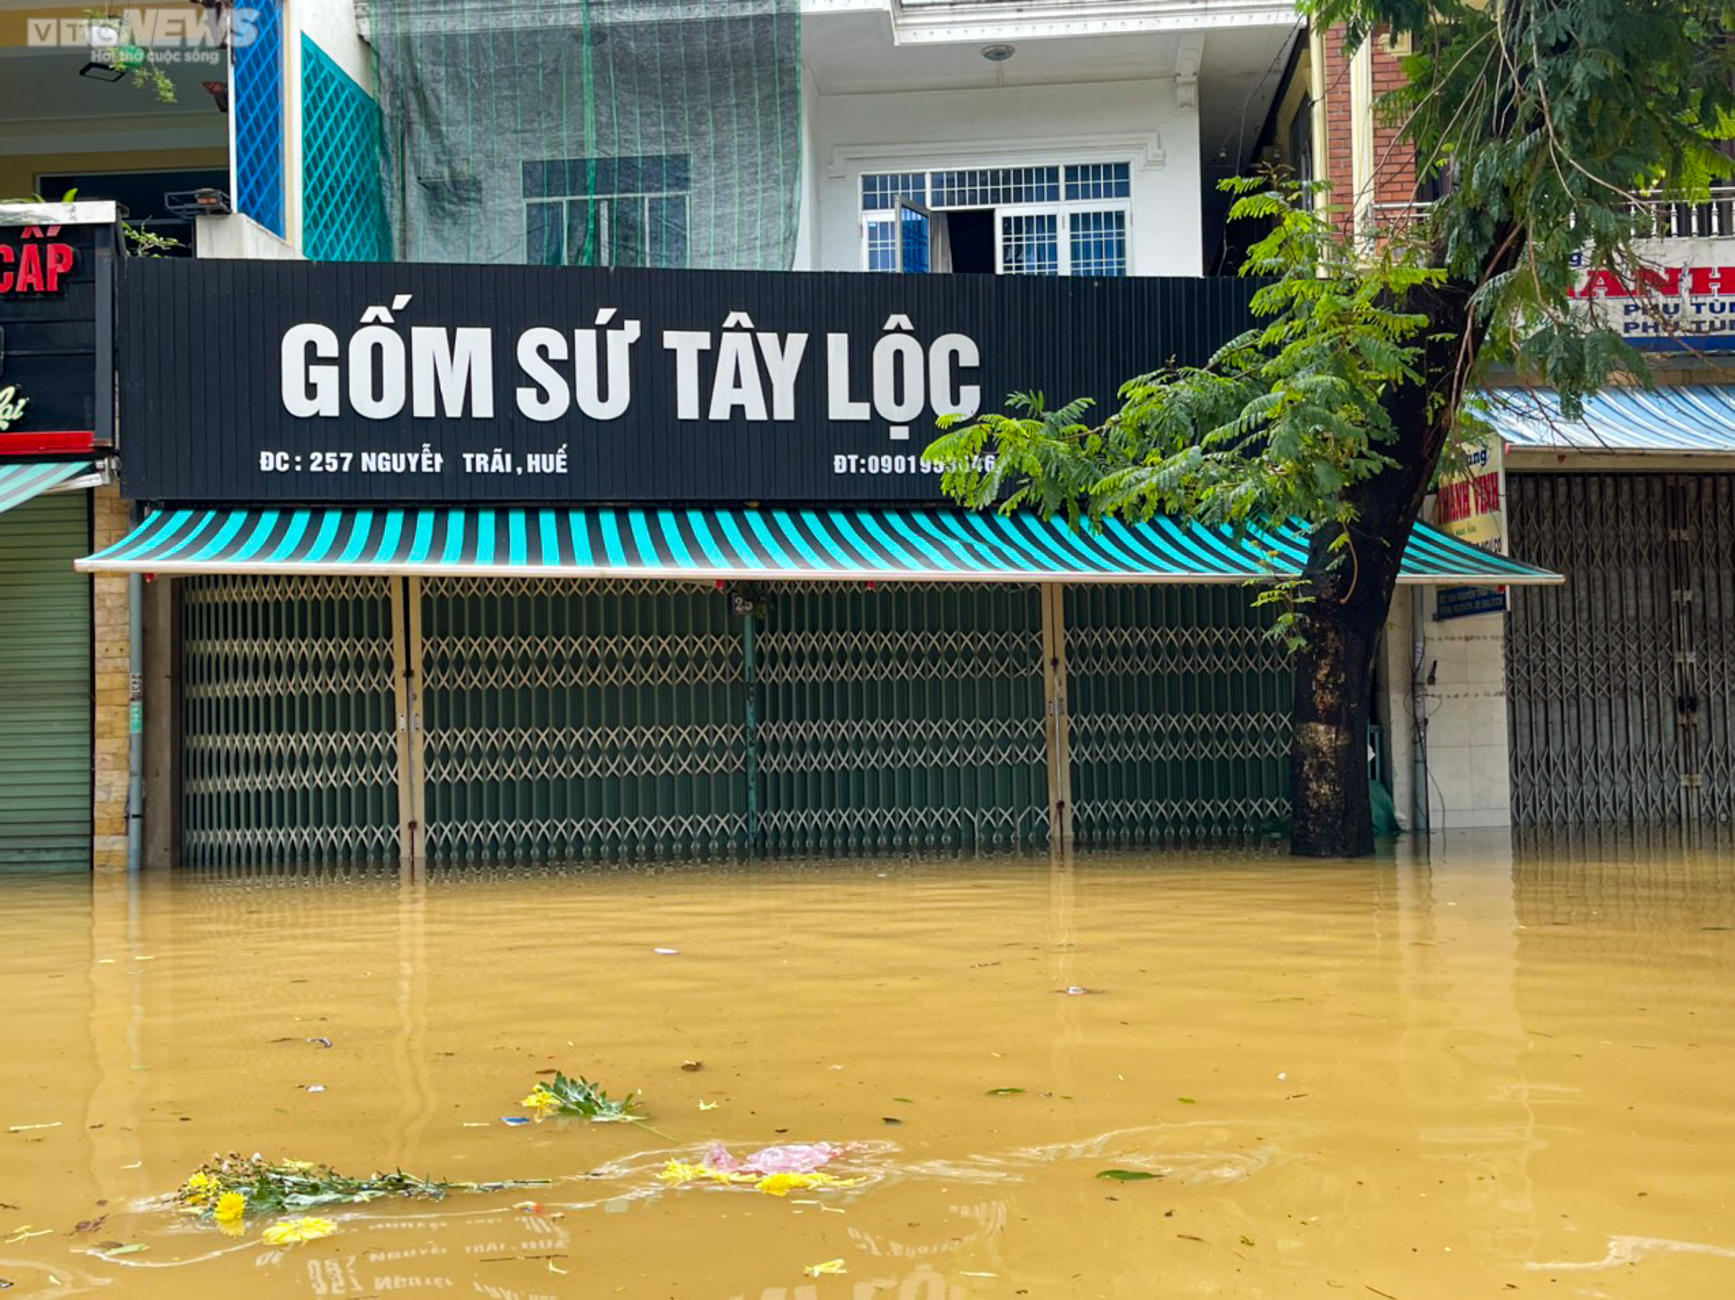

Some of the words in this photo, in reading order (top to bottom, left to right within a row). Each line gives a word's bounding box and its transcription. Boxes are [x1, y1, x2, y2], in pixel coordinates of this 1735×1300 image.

[282, 295, 493, 420] GỐM
[516, 308, 641, 422] SỨ
[663, 312, 808, 421] TÂY
[827, 313, 982, 440] LỘC
[309, 451, 354, 473] 257
[526, 443, 568, 474] HUẾ
